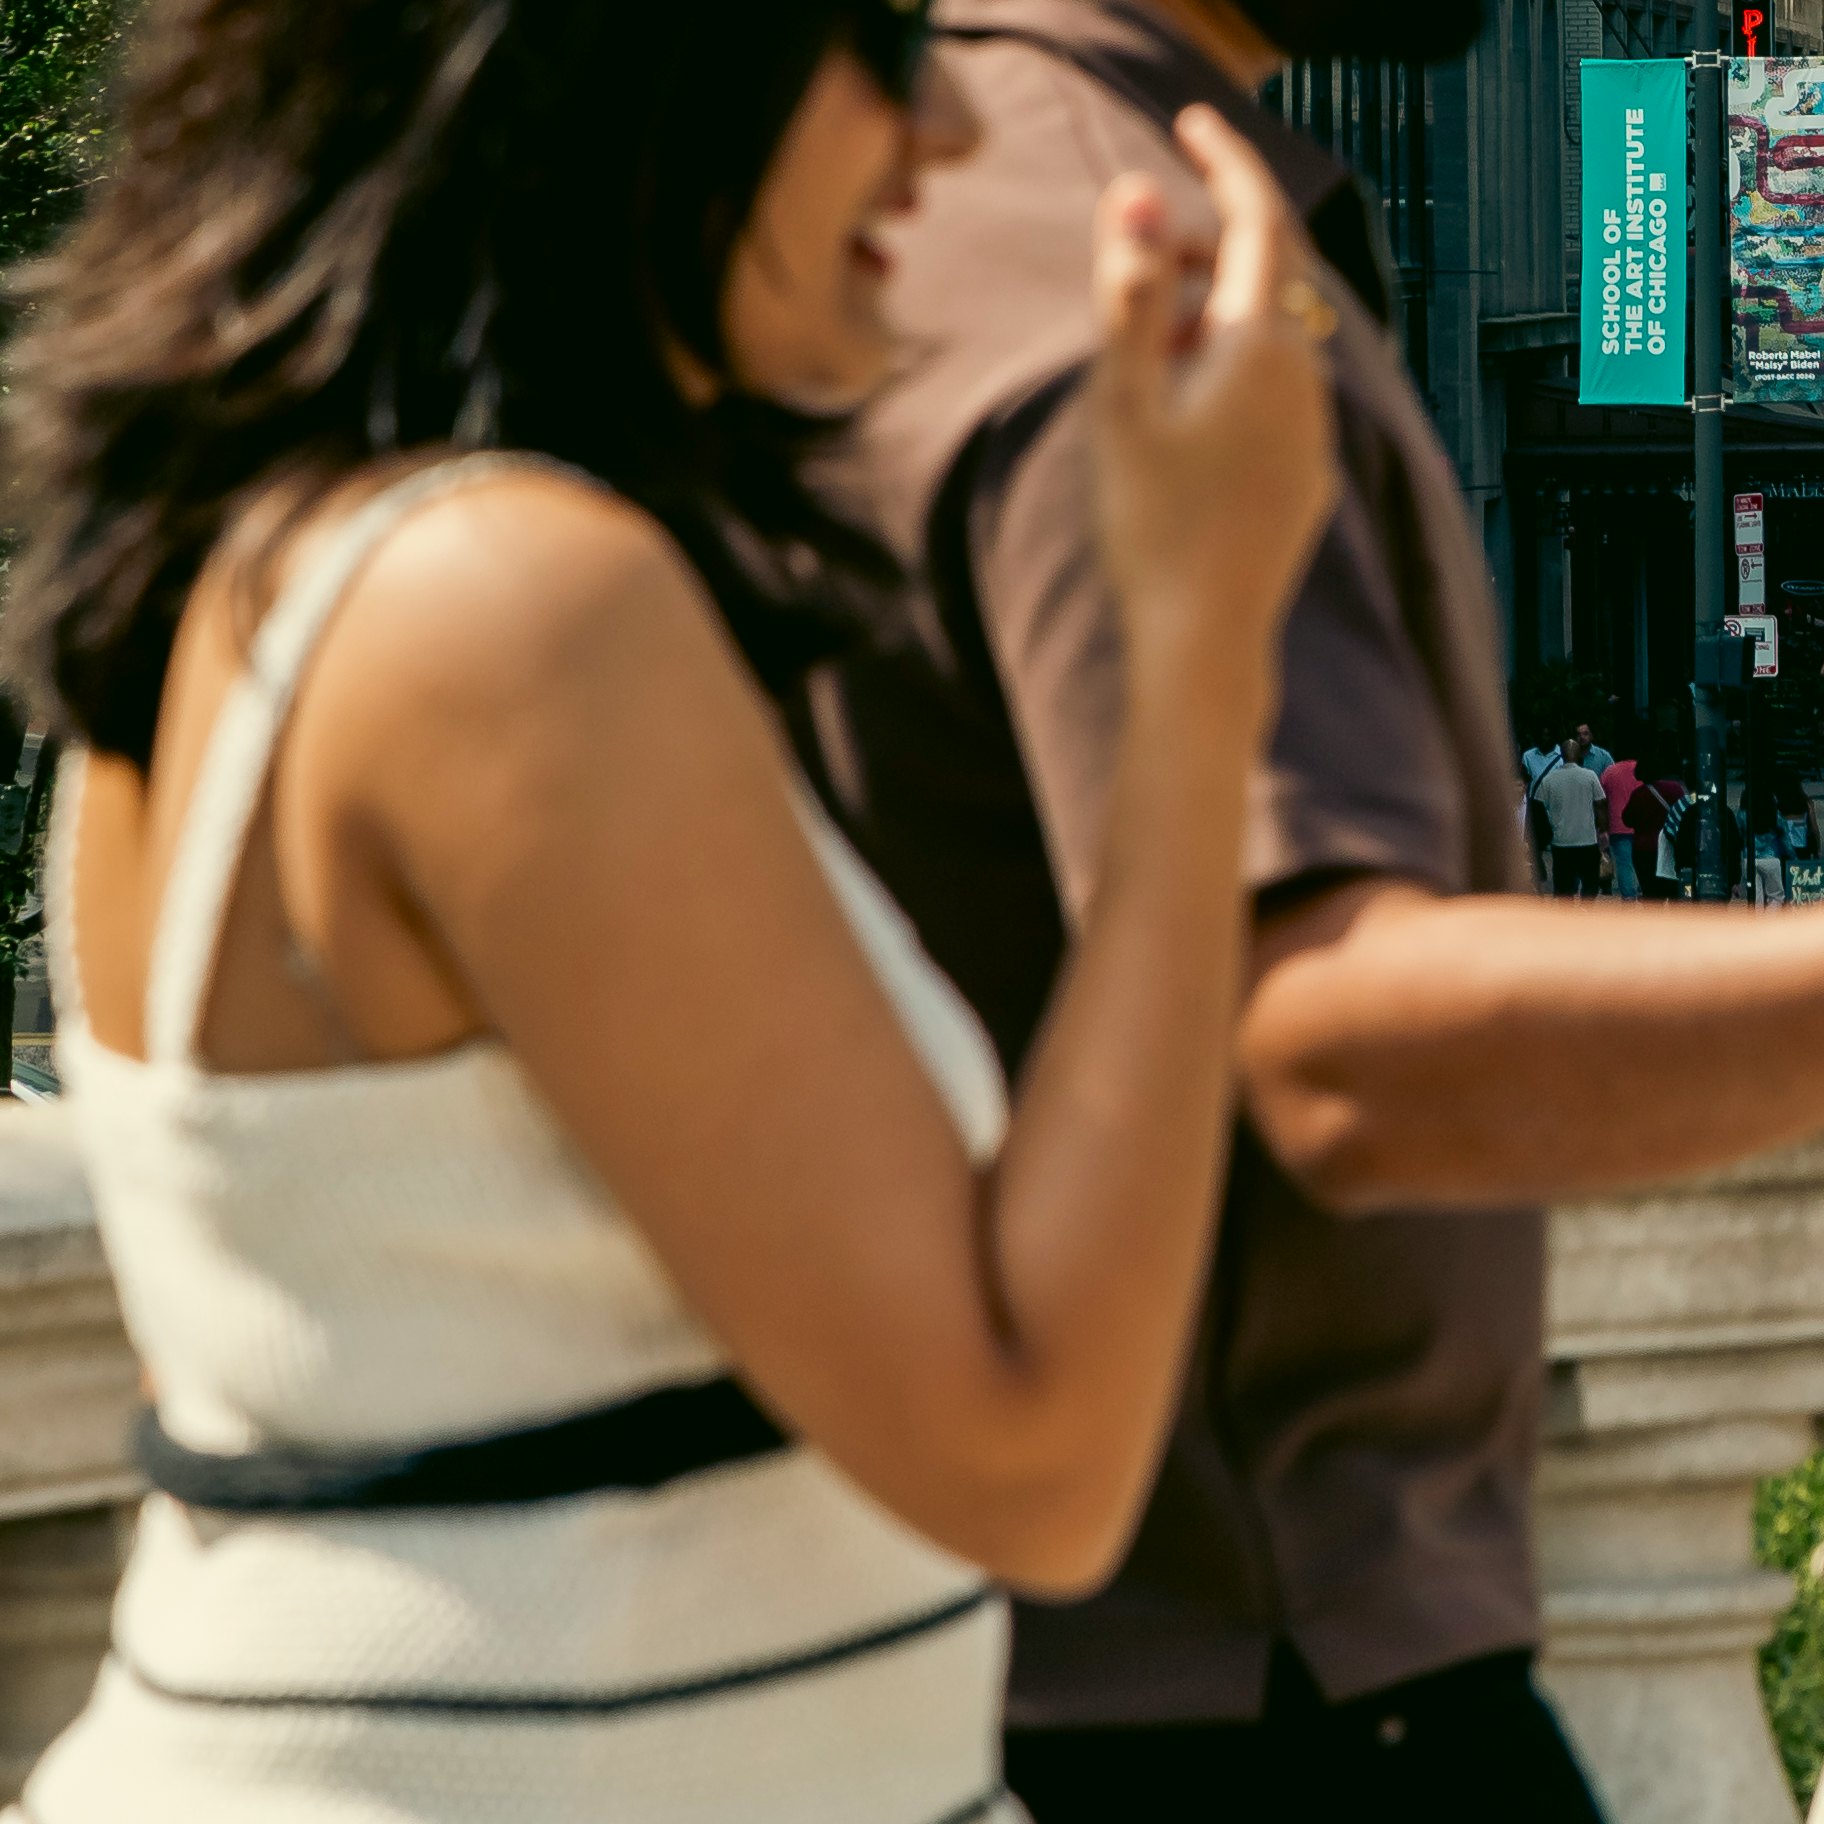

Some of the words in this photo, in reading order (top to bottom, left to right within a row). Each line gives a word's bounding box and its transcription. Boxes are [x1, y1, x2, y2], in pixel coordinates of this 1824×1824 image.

[1625, 109, 1644, 241] INSTITUTE
[1603, 209, 1622, 243] OF
[1625, 247, 1644, 298] ART
[1648, 199, 1668, 314] CHICAGO
[1602, 250, 1622, 355] SCHOOL
[1625, 305, 1645, 355] THE
[1647, 320, 1667, 355] OF
[1748, 350, 1788, 360] Roberta
[1790, 350, 1821, 360] Mabel
[1790, 359, 1820, 369] Biden
[1790, 865, 1824, 886] What
